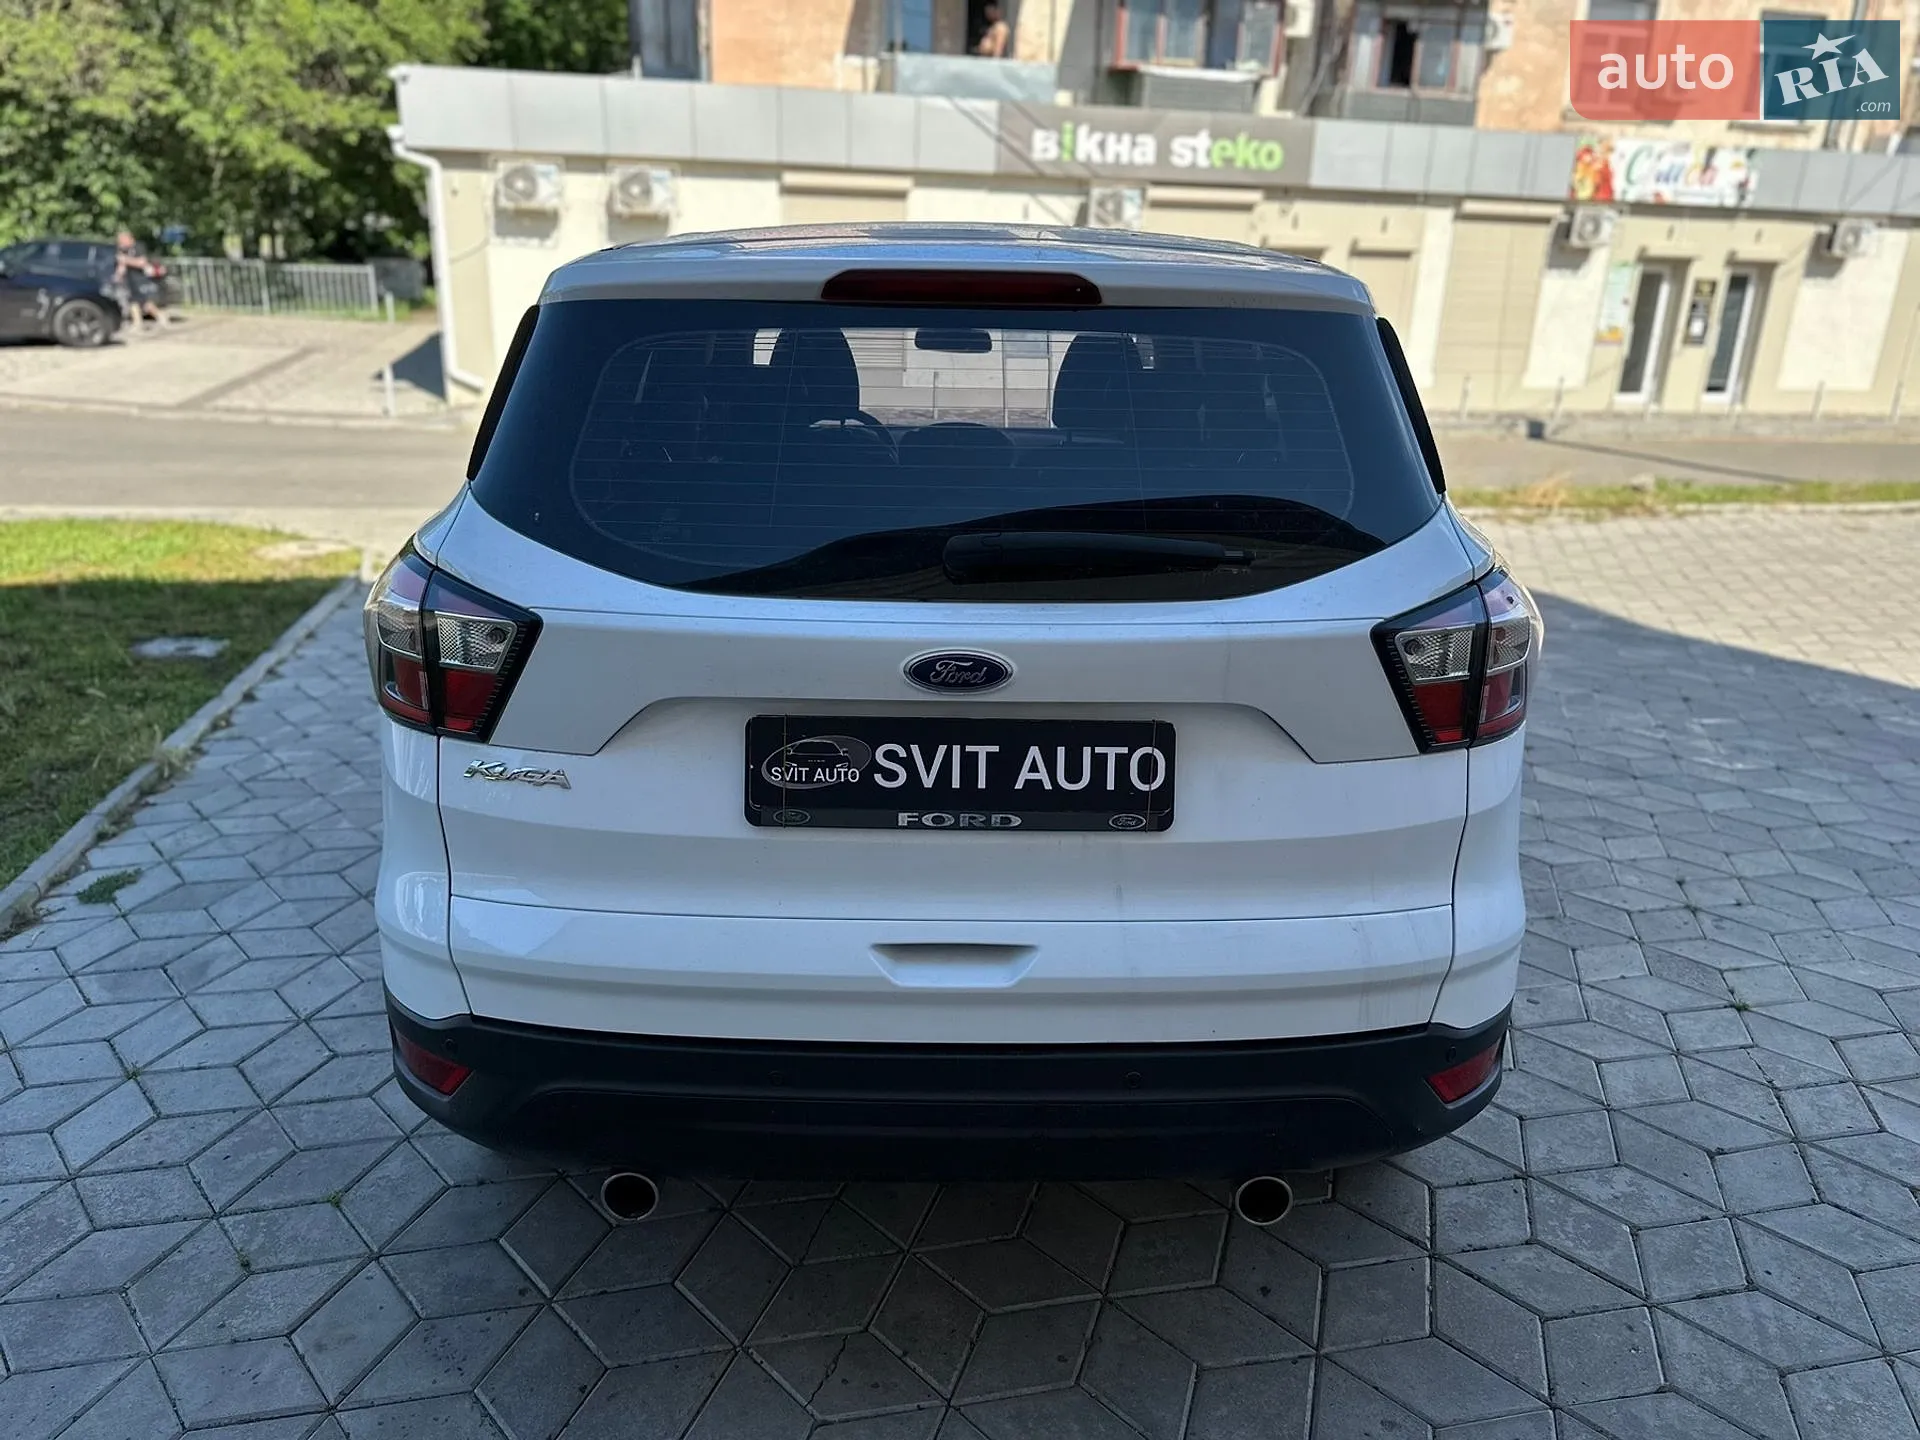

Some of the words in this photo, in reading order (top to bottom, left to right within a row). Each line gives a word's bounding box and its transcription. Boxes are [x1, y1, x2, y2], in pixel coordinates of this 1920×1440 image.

[1169, 128, 1284, 171] steko
[929, 659, 988, 684] Ford
[770, 767, 809, 782] SVIT
[813, 767, 860, 783] AUTO
[873, 743, 1000, 790] SVIT
[1014, 745, 1167, 792] AUTO
[897, 812, 1022, 829] FORD
